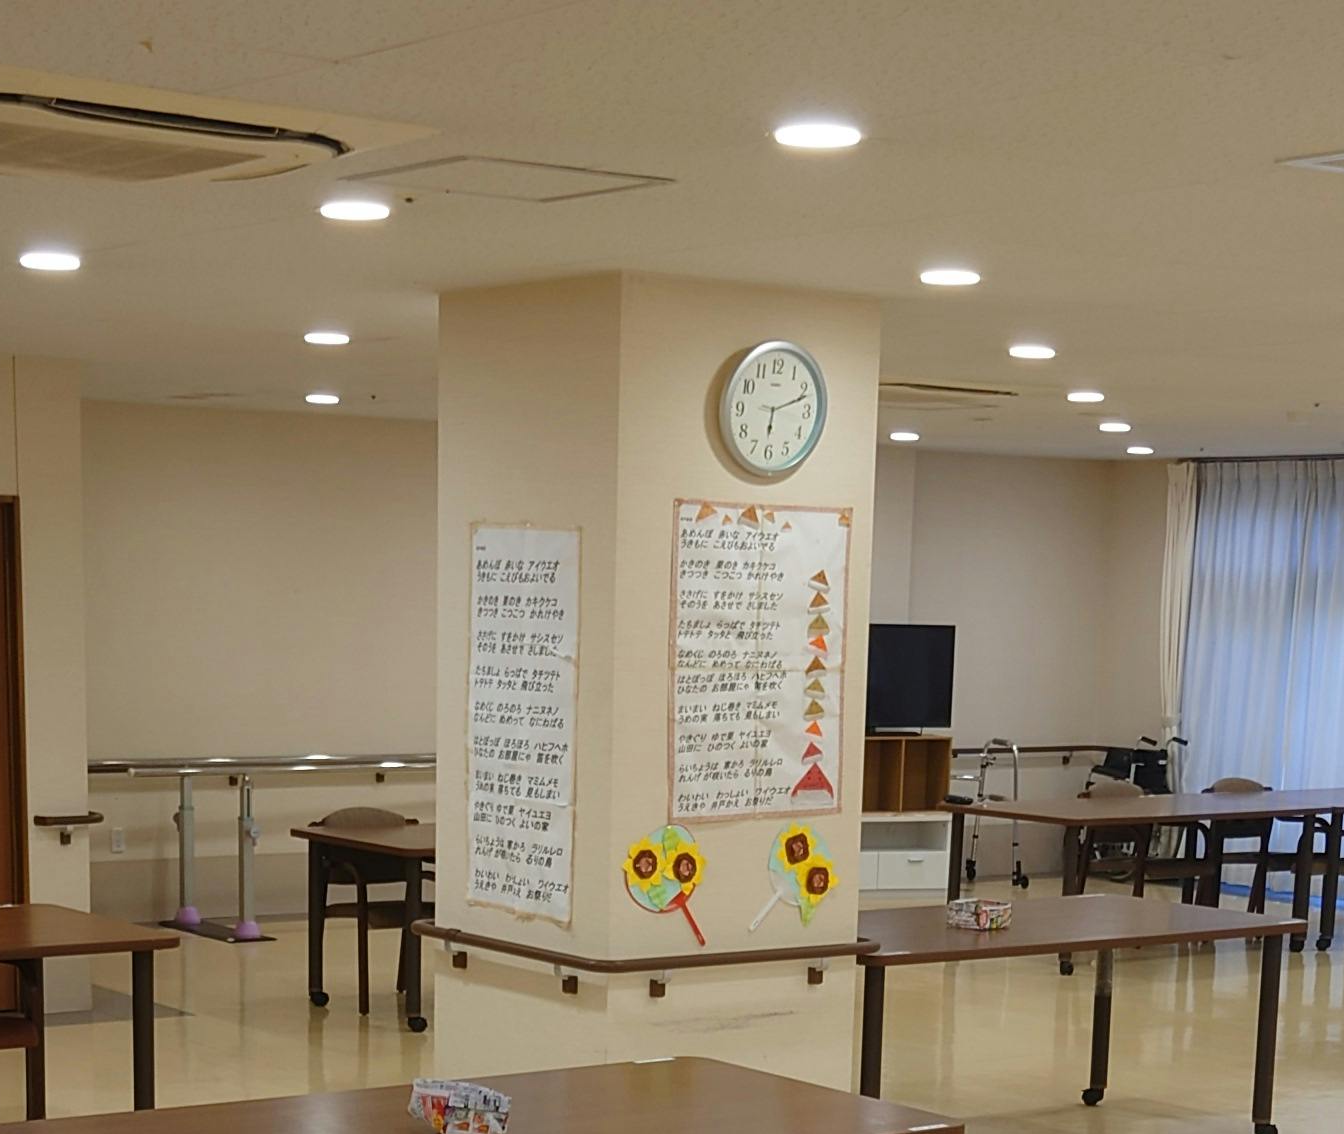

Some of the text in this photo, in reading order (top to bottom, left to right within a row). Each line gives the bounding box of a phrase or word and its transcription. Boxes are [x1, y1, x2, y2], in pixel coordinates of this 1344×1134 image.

[756, 363, 766, 379] 11
[772, 359, 784, 375] 12
[792, 366, 796, 380] 1
[743, 379, 755, 394] 10
[800, 382, 807, 396] 2
[736, 401, 744, 416] 9
[802, 404, 811, 419] 3
[739, 424, 748, 438] 8
[795, 426, 802, 439] 4
[750, 440, 758, 455] 7
[764, 445, 772, 460] 6
[782, 441, 790, 456] 5
[745, 532, 779, 541] アイウエオ
[680, 560, 710, 569] かきのき
[743, 562, 776, 571] カキクケコ
[680, 570, 708, 579] きつつき
[714, 571, 742, 579] こつこつ
[748, 592, 783, 600] サシスセソ
[750, 621, 780, 630] タチツテト
[678, 631, 702, 639] トテトテ
[742, 651, 777, 659] ナニヌネノ
[678, 705, 706, 713] まいまい
[747, 701, 778, 710] マミムメモ
[679, 744, 702, 753] 山田に
[750, 758, 782, 767] ラリルレロ
[679, 792, 708, 802] わいわい
